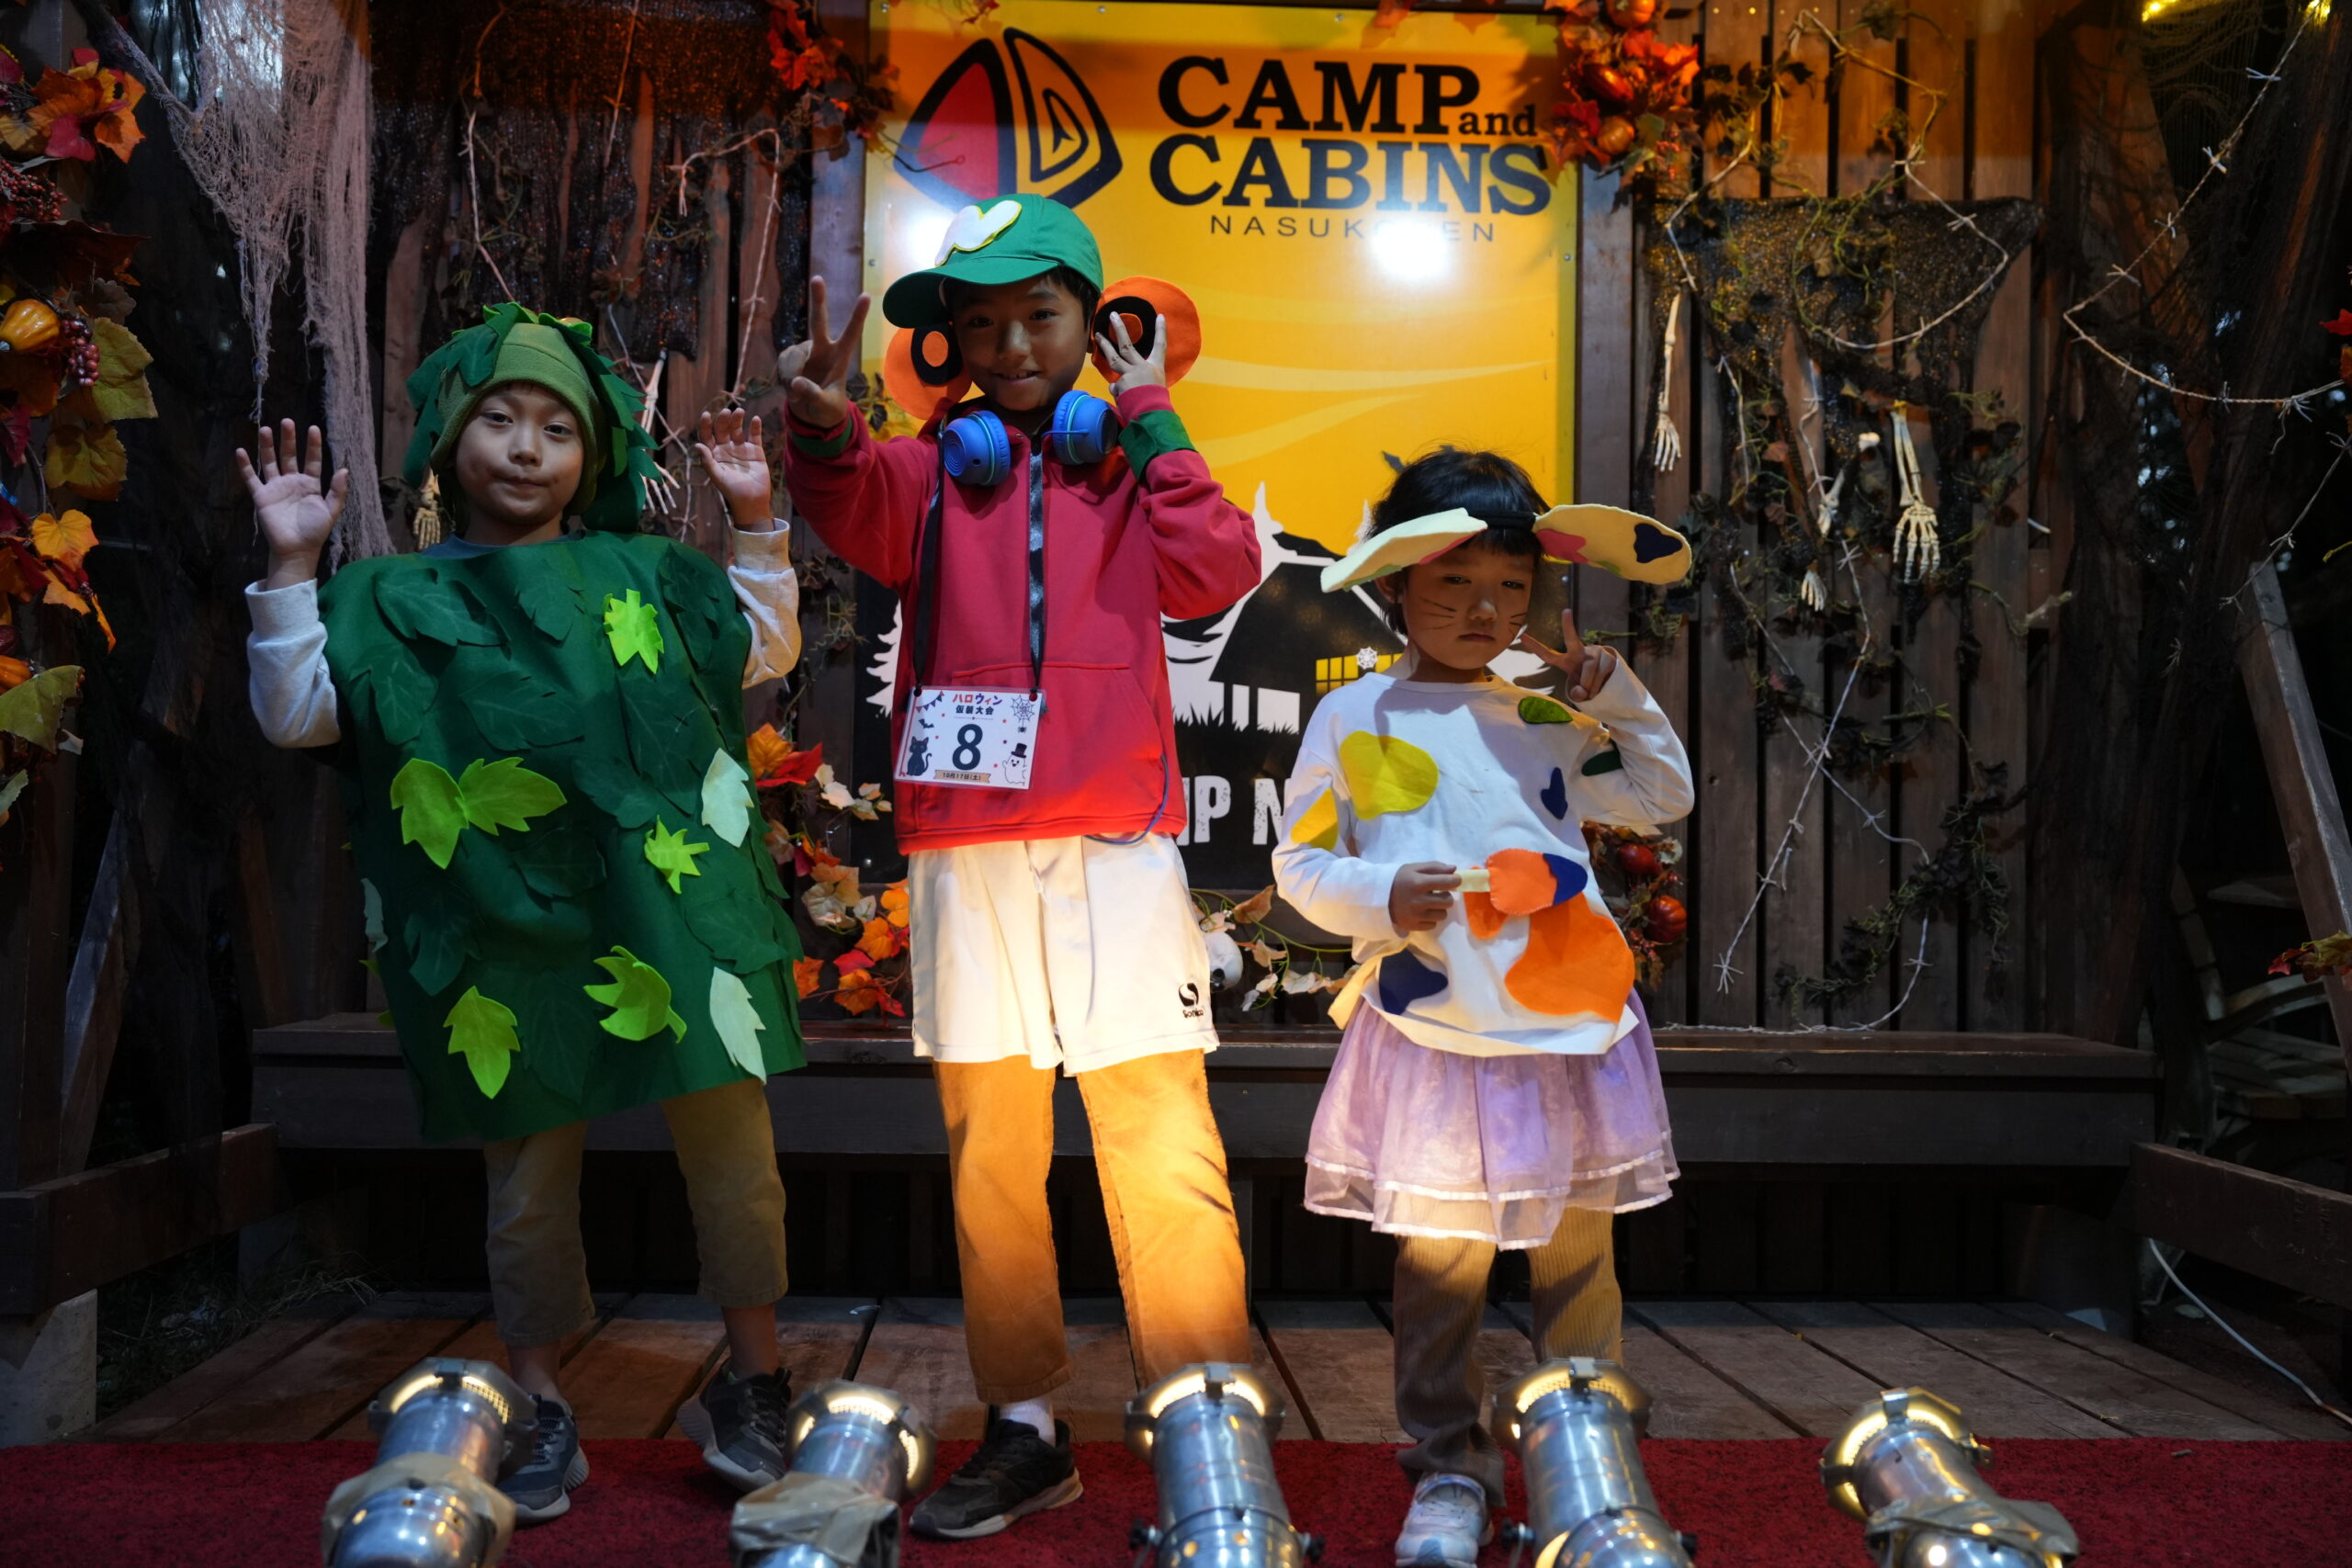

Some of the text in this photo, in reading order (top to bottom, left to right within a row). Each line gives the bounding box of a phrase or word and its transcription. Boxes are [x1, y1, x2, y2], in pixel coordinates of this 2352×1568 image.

[1159, 55, 1539, 137] CAMP and
[1148, 133, 1552, 216] CABINS
[1211, 214, 1494, 243] NASUKEN
[952, 694, 1002, 705] ハロウィン
[956, 705, 994, 716] 仮装大会
[952, 724, 983, 770] 8
